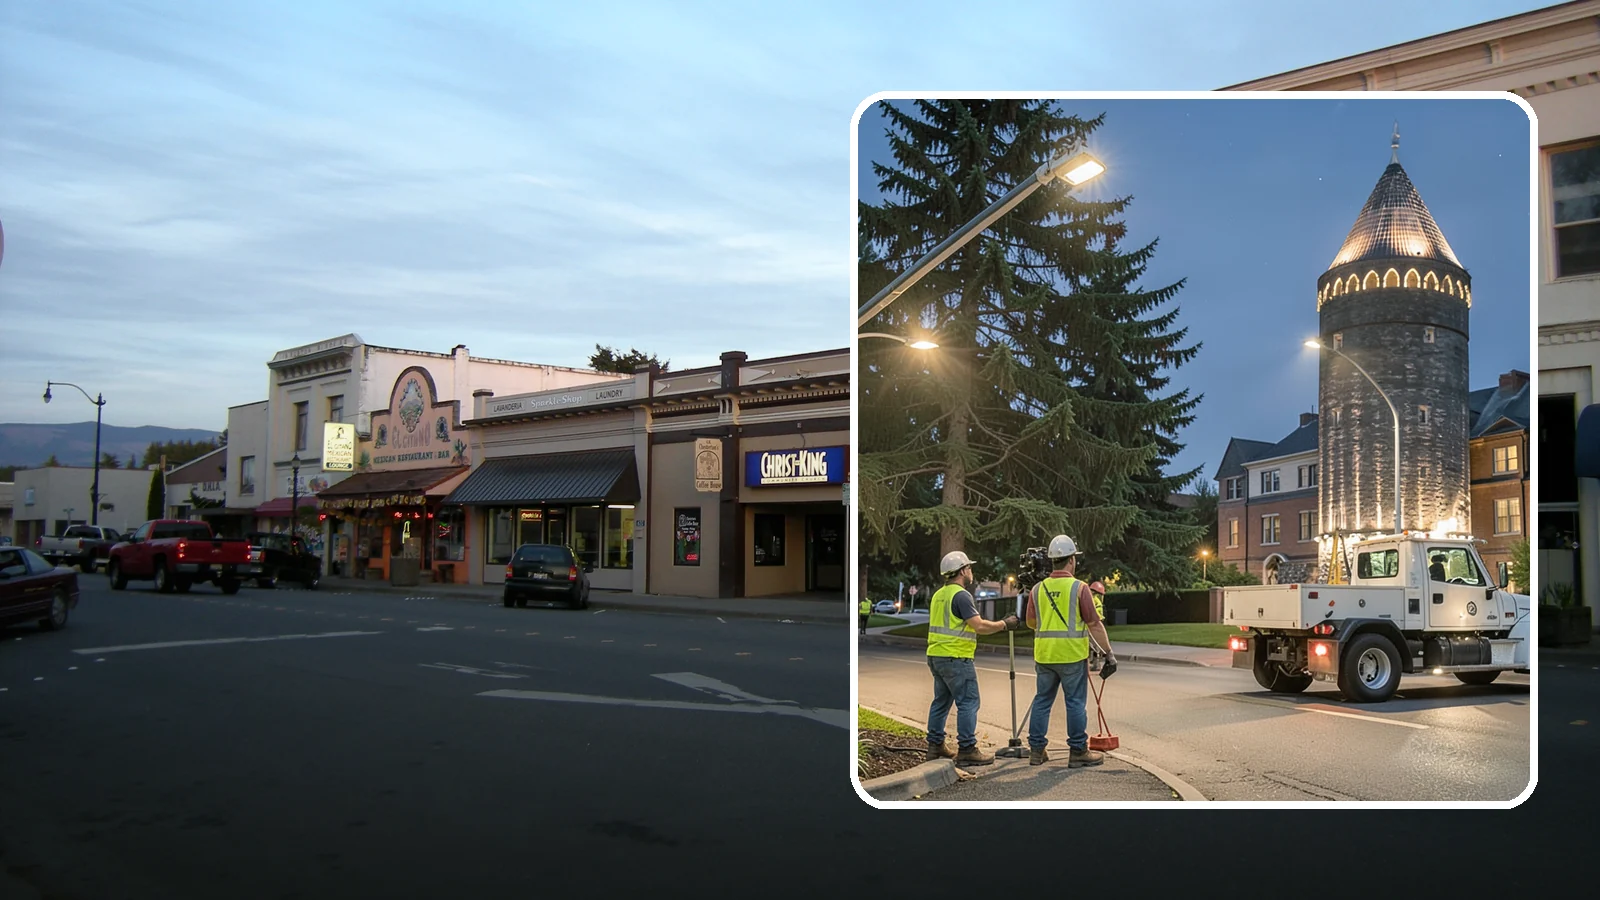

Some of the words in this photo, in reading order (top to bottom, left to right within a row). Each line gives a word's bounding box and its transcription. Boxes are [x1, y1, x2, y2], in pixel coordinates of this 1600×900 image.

[561, 394, 583, 405] Shop
[595, 389, 623, 400] LAUNDRY
[493, 402, 523, 413] LAVANDERIA
[374, 455, 396, 464] MEXICAN
[397, 451, 434, 462] RESTAURANT
[437, 450, 450, 459] BAR
[760, 452, 797, 478] CHRIST
[799, 450, 827, 476] KING
